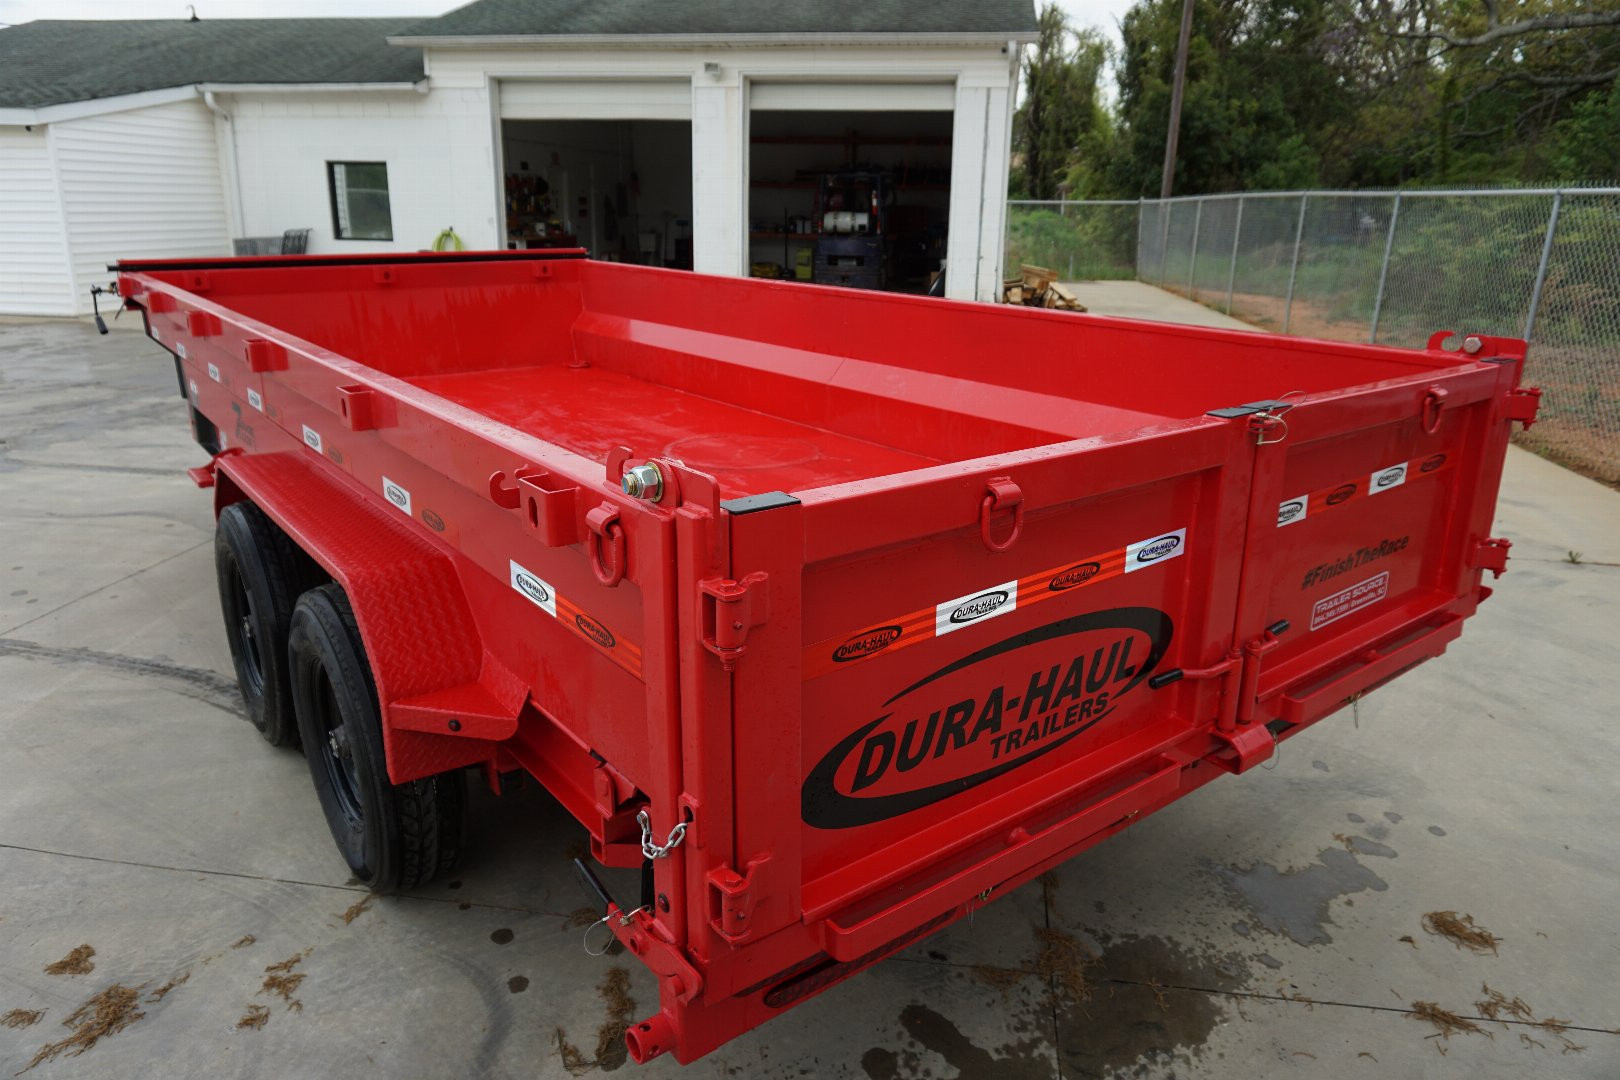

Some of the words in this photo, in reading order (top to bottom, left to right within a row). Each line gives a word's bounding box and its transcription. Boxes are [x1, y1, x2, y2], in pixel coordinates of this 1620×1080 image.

[1141, 539, 1175, 558] DURA-HAUL
[1301, 535, 1409, 590] #FinishTheRace
[519, 576, 545, 599] DURA-HAUL
[1055, 566, 1095, 587] DURA-HAUL
[956, 595, 1002, 619] DURA-HAUL
[1316, 592, 1351, 614] TRAILER
[1352, 577, 1384, 598] SOURCE
[579, 617, 611, 644] DURA-HAUL
[840, 630, 896, 657] DURA-HAUL
[850, 636, 1135, 794] DURA-HAUL
[989, 691, 1110, 761] TRAILERS
